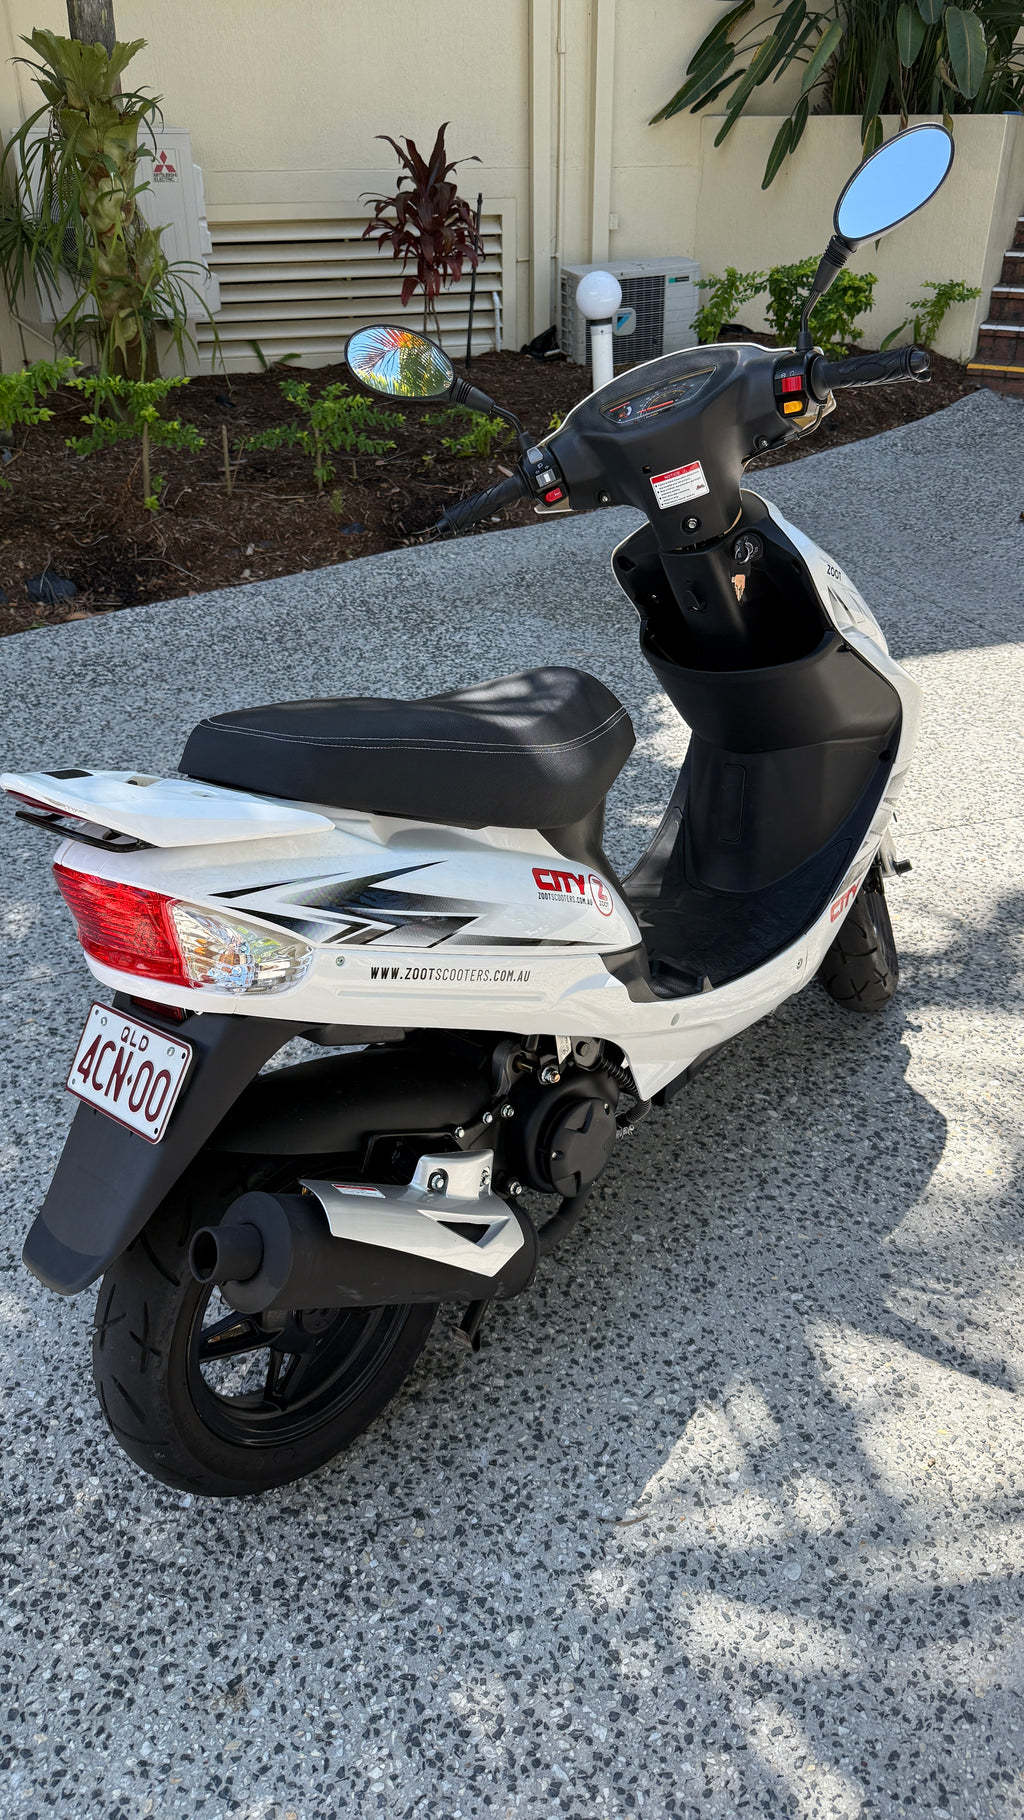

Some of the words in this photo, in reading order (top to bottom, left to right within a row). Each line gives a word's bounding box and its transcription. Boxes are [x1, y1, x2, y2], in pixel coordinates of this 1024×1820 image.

[826, 564, 842, 581] ZOOT
[532, 867, 585, 895] CITY
[537, 891, 593, 906] ZOOTSCOOTERS.COM.AU
[830, 878, 862, 923] CITY
[370, 966, 531, 982] WWW.ZOOTSCOOTERS.COM.AU
[120, 1026, 150, 1052] QLD
